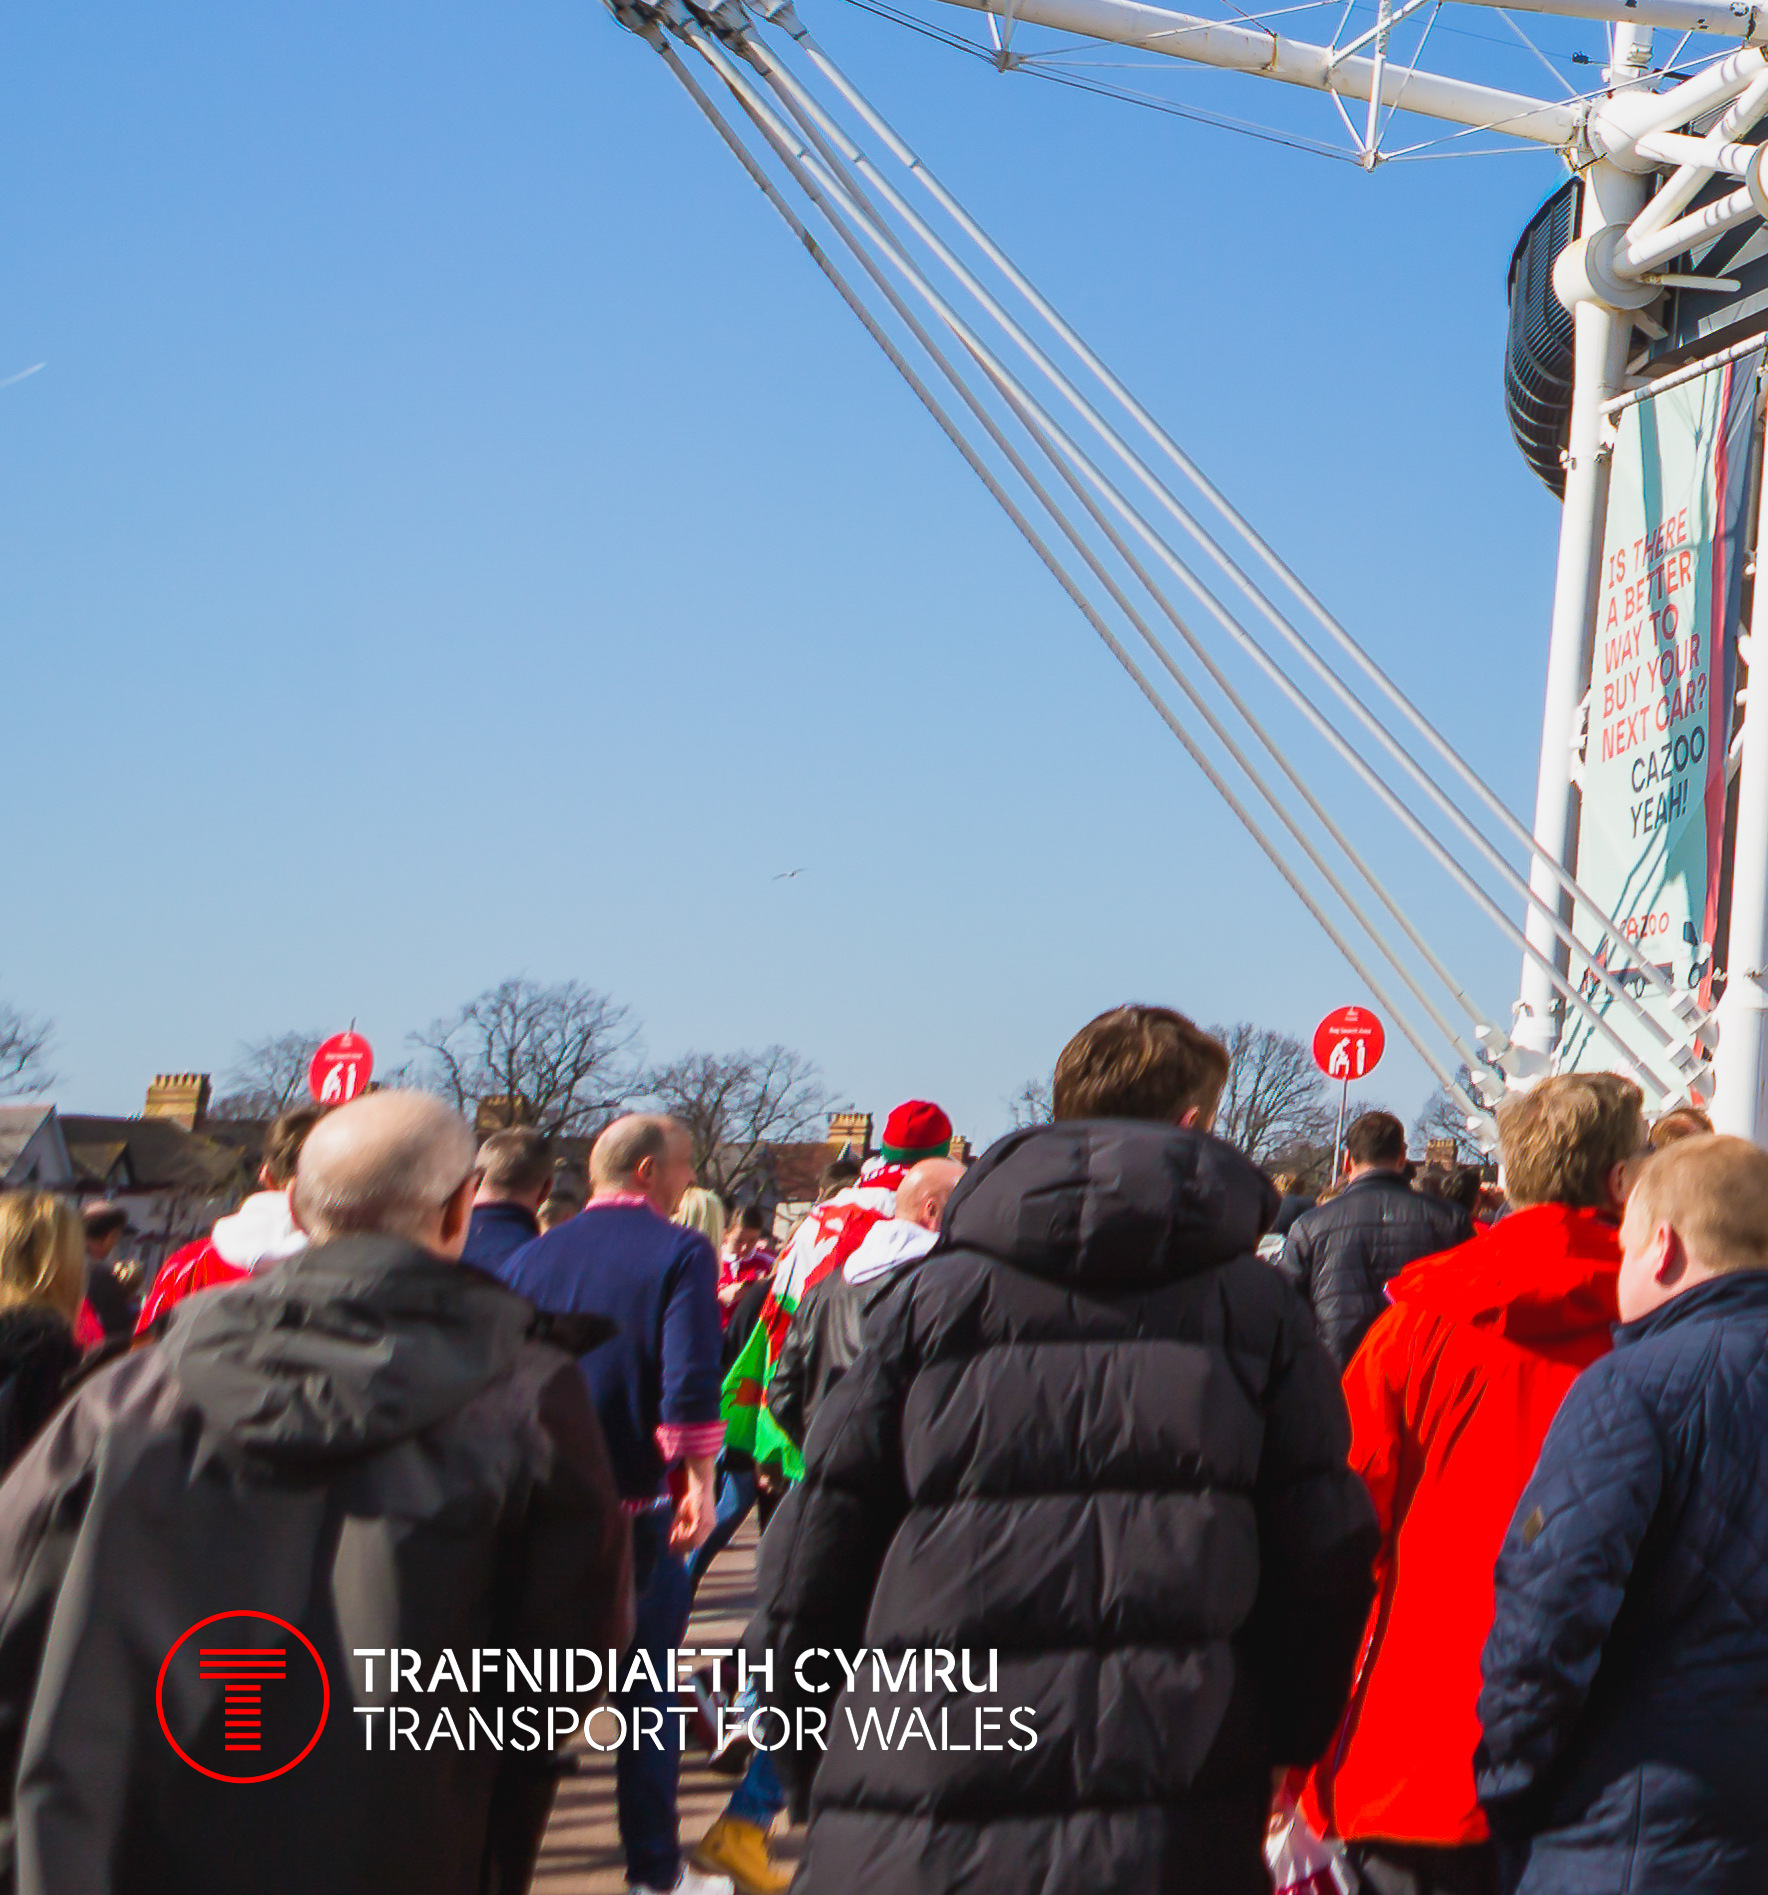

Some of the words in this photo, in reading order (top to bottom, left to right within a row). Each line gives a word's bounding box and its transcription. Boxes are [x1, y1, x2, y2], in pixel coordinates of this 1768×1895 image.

[1607, 548, 1626, 590] IS
[1633, 506, 1688, 573] THERE
[1604, 596, 1618, 633] A
[1623, 549, 1692, 622] BETTER
[1602, 665, 1641, 719] BUY
[1646, 632, 1700, 694] YOUR
[1604, 619, 1643, 675] WAY
[1648, 603, 1679, 647] TO
[1601, 704, 1650, 763] NEXT
[1655, 672, 1707, 732] CAR?
[1630, 725, 1706, 793] CAZOO
[1630, 778, 1689, 839] YEAH!
